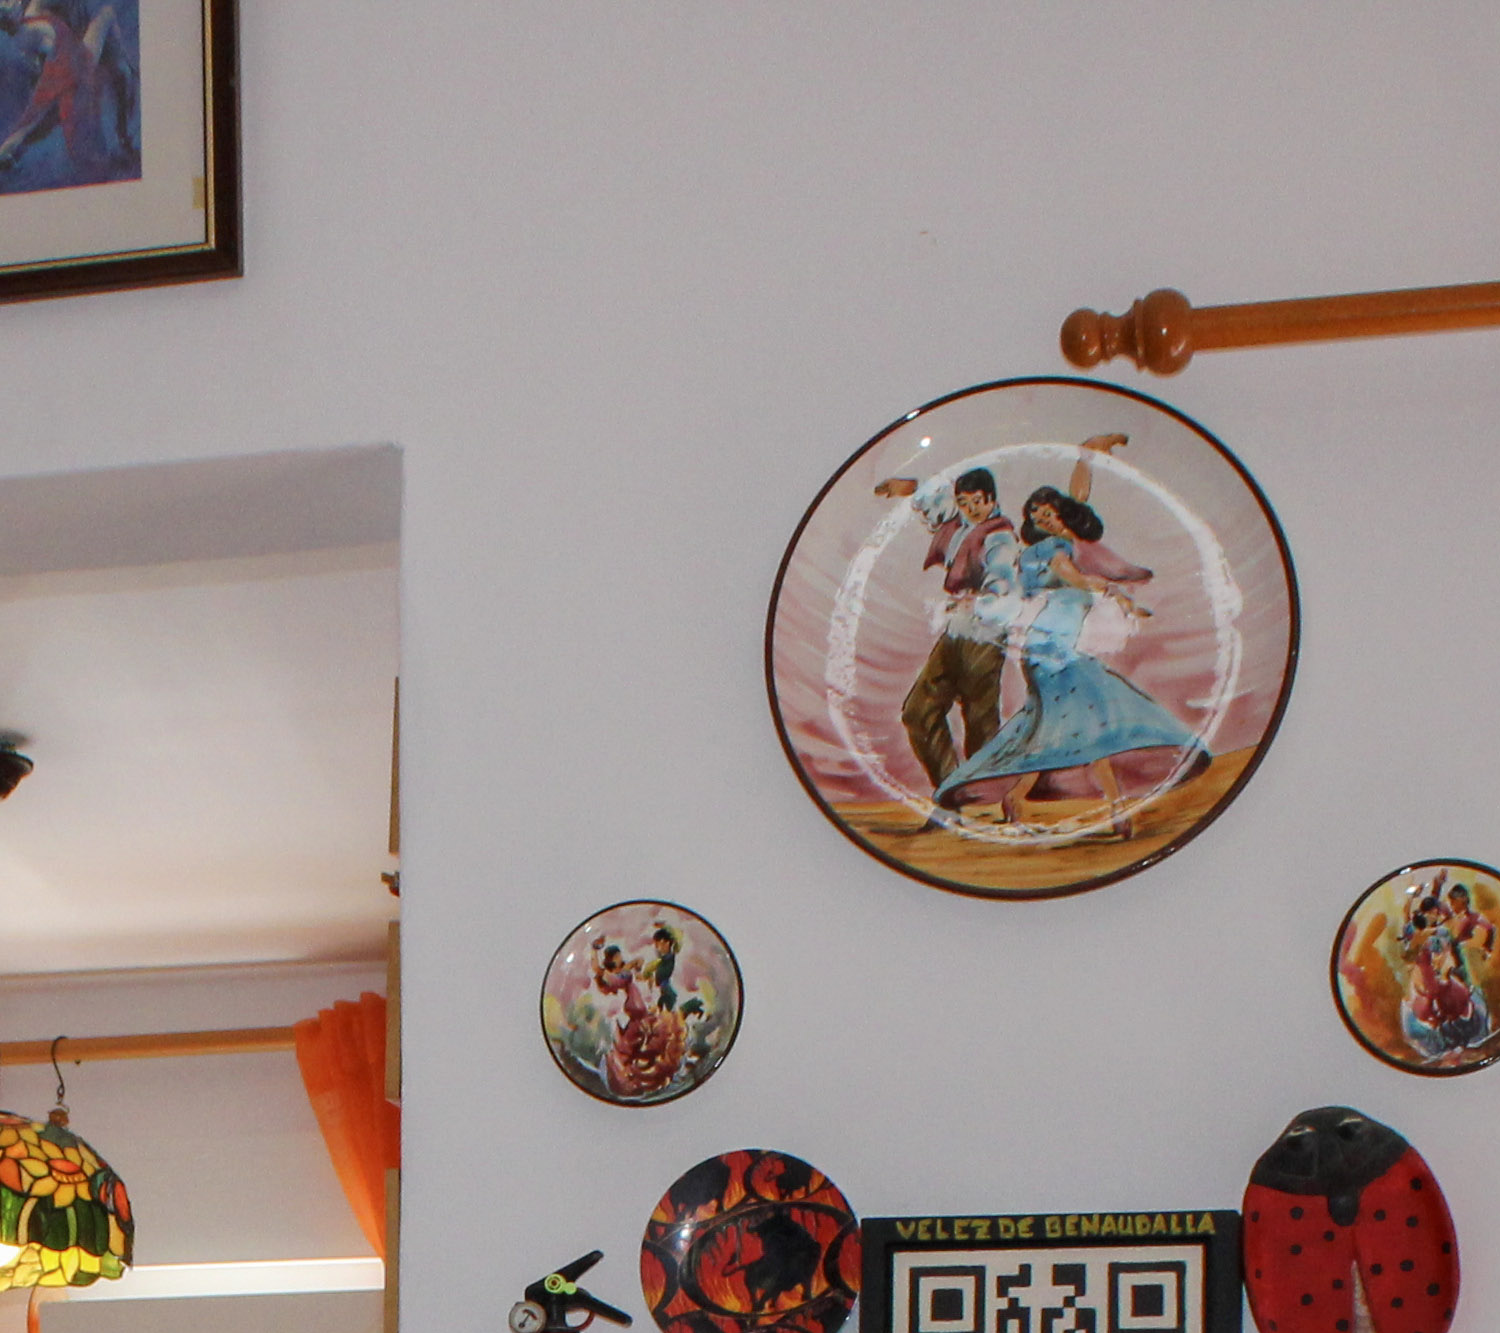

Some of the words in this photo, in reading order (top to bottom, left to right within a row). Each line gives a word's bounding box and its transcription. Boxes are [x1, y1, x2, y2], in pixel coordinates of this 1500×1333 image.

[896, 1217, 992, 1241] VELEZ
[998, 1216, 1035, 1239] DE
[1045, 1211, 1216, 1238] BENAUDALLA
